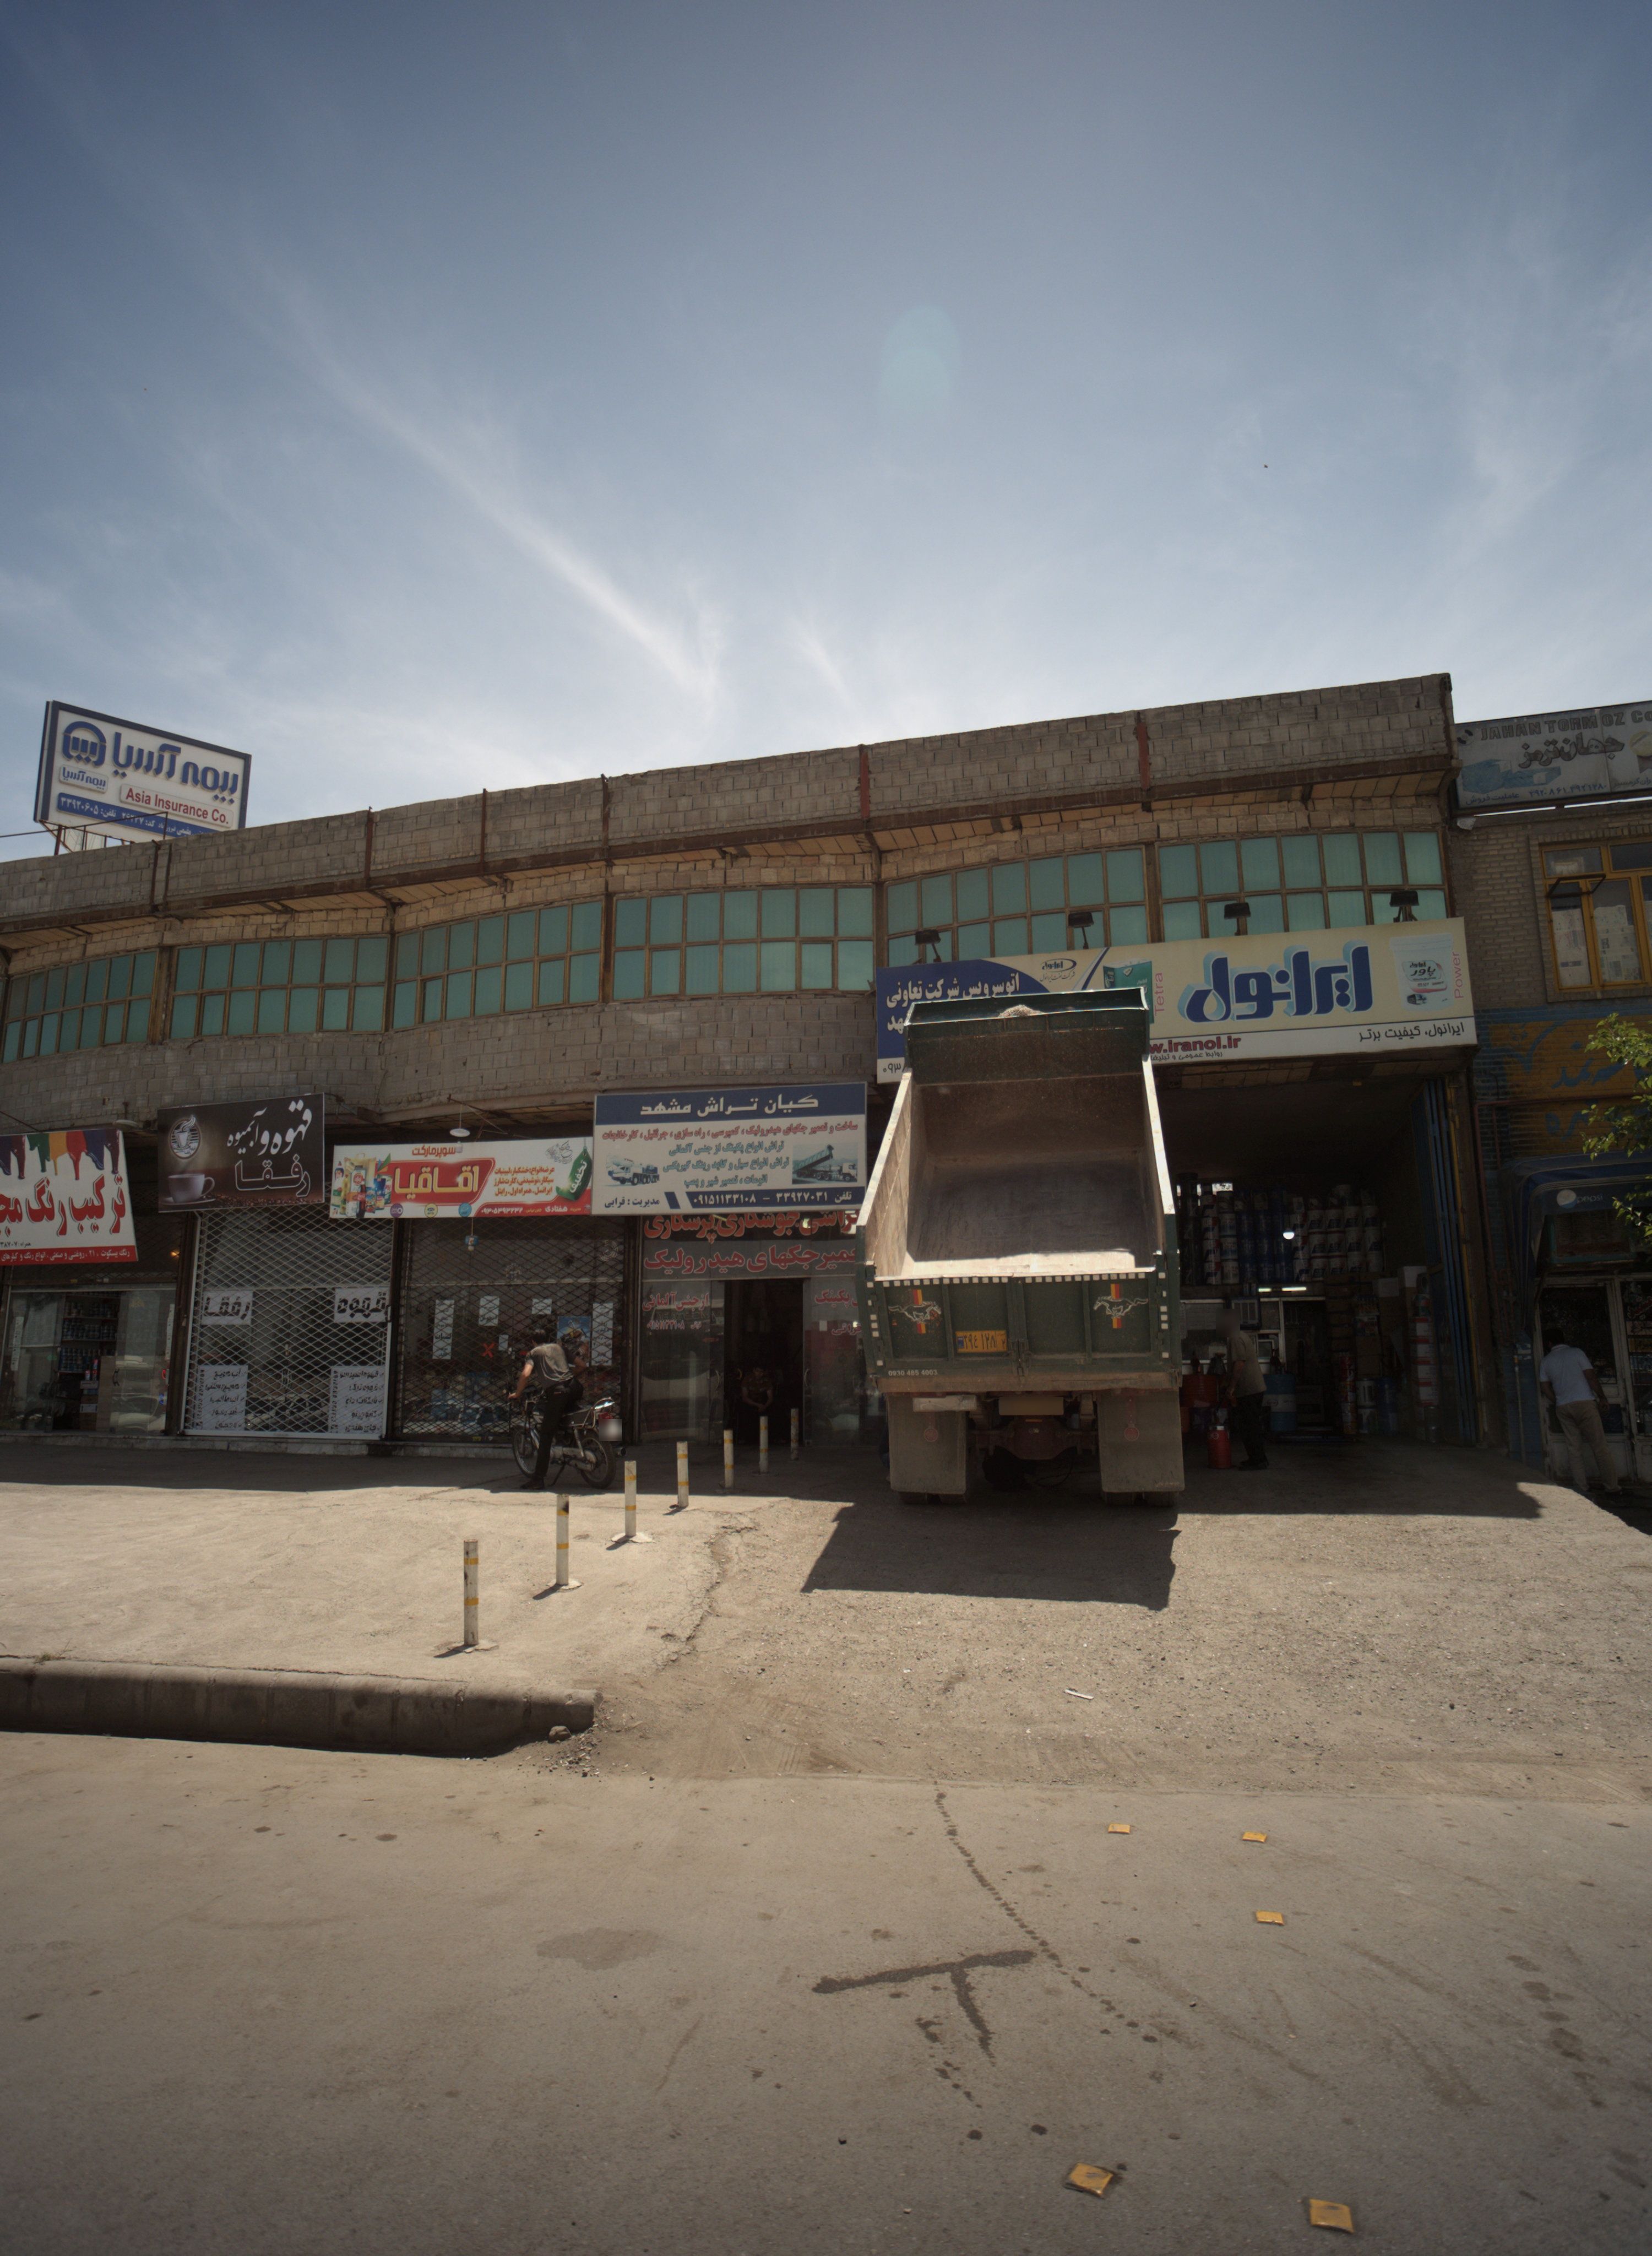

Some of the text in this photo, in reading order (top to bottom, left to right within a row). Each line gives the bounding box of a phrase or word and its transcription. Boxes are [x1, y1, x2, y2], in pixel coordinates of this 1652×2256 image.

[1481, 722, 1541, 741] JAHAN
[62, 767, 107, 791] بیمه آسیا
[112, 731, 240, 805] بیمه آسیا
[126, 788, 151, 805] Asia
[154, 794, 209, 820] Insurance
[211, 809, 229, 825] Co.
[1181, 942, 1373, 1023] ایرانول
[1410, 966, 1436, 977] پاور
[1452, 951, 1464, 999] Power
[885, 980, 923, 1008] تعاونی
[925, 978, 960, 1001] شرکت
[1154, 972, 1165, 1016] Tetra
[1358, 1029, 1382, 1042] برتر
[1384, 1026, 1421, 1040] کیفیت
[1150, 1035, 1242, 1054] w.iranol.ir
[640, 1093, 819, 1118] کیان تراش مشهد
[270, 1099, 313, 1155] قهوه
[808, 1122, 828, 1136] تعمیر
[828, 1125, 834, 1135] و
[835, 1121, 858, 1131] ساخت
[411, 1145, 457, 1158] سوپرمارکت
[744, 1140, 764, 1154] انواع
[764, 1140, 785, 1153] تراش
[749, 1157, 769, 1171] انواع
[769, 1156, 790, 1169] تراش
[235, 1154, 311, 1197] رفقا
[394, 1164, 480, 1200] اقاقیا
[569, 1160, 588, 1194] تخفیف
[26, 1177, 67, 1237] رنگ
[69, 1174, 127, 1235] ترکیب
[693, 1191, 853, 1206] تلفن ۳۳۹۲۷۰۳۱ ۰۹۱۵۱۱۳۳۱۰۸
[1577, 1194, 1604, 1204] pepsi
[644, 1244, 855, 1275] عمیر جکهای هیدرولیک
[642, 1291, 710, 1313] از جنس آلمانی
[814, 1288, 851, 1309] پکینگ
